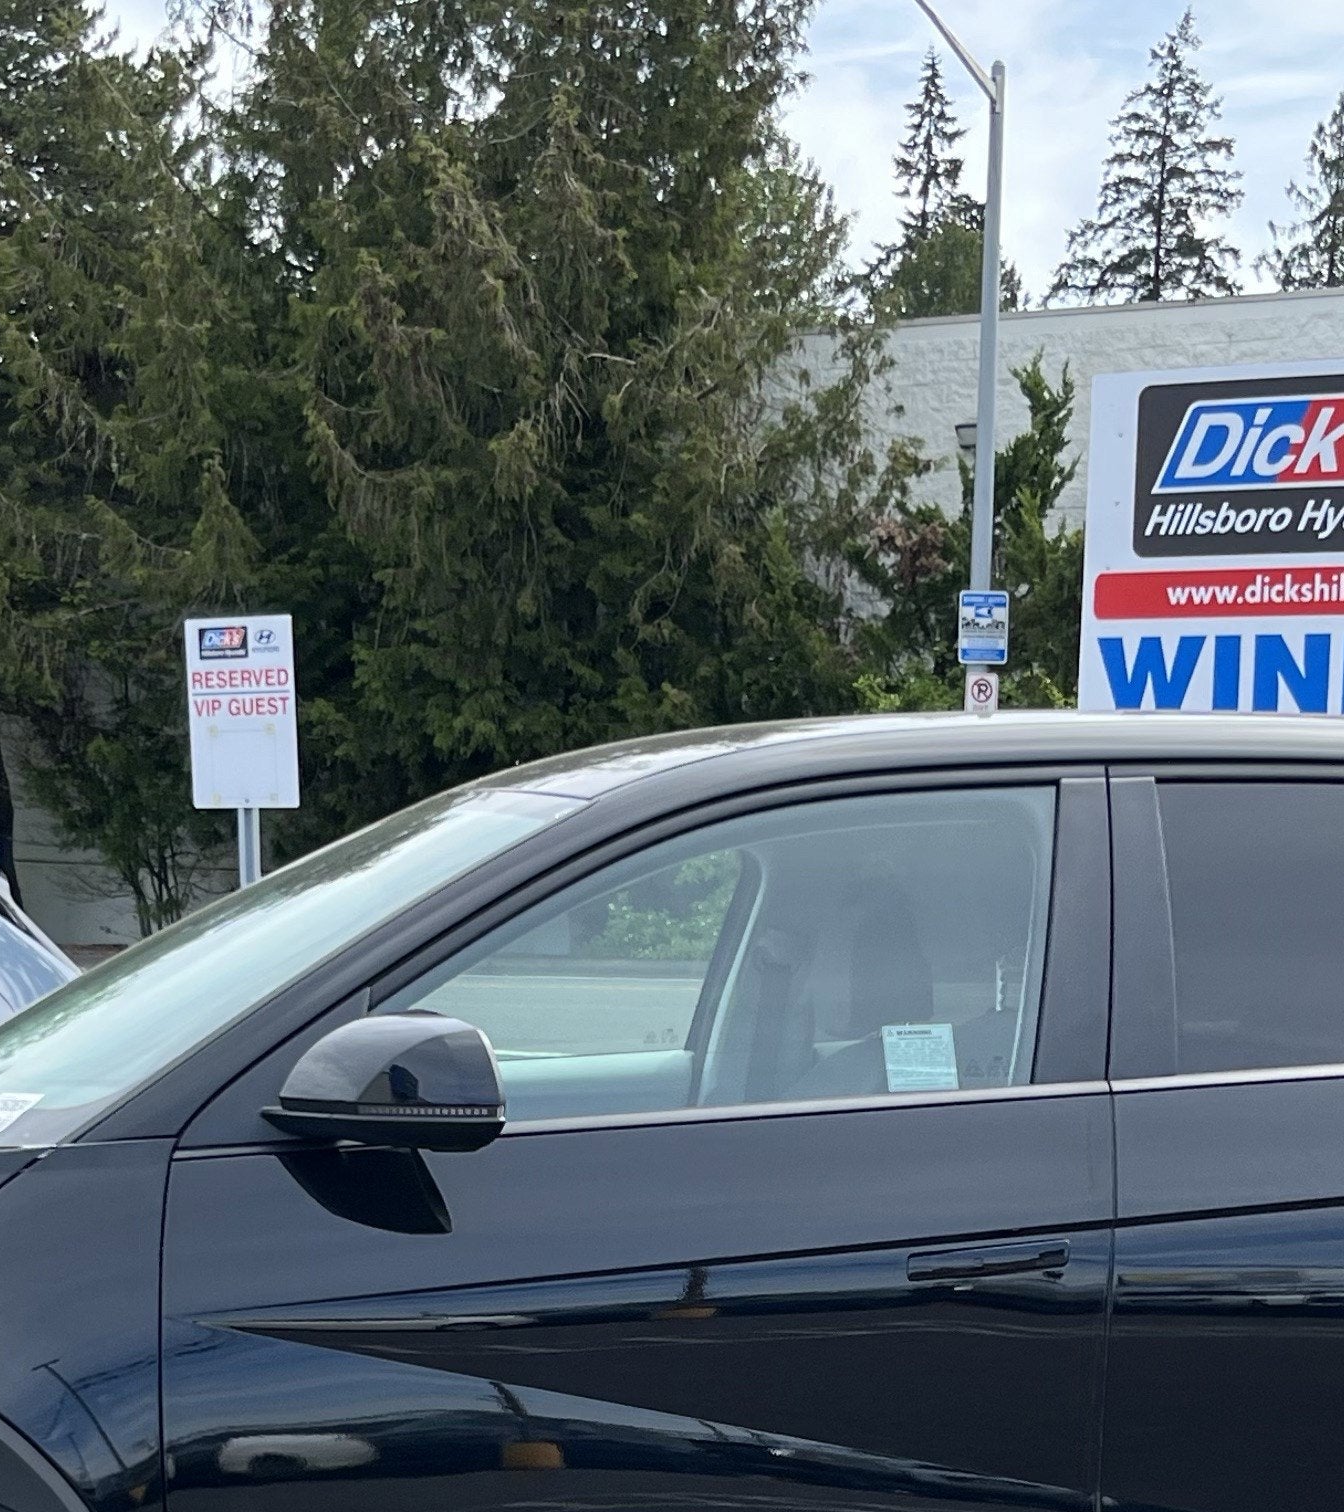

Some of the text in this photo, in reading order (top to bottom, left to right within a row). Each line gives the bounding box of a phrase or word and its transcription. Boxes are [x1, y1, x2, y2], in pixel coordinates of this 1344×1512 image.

[1144, 501, 1292, 536] Hillsboro
[192, 669, 289, 690] RESERVED
[194, 697, 289, 717] VIP GUEST
